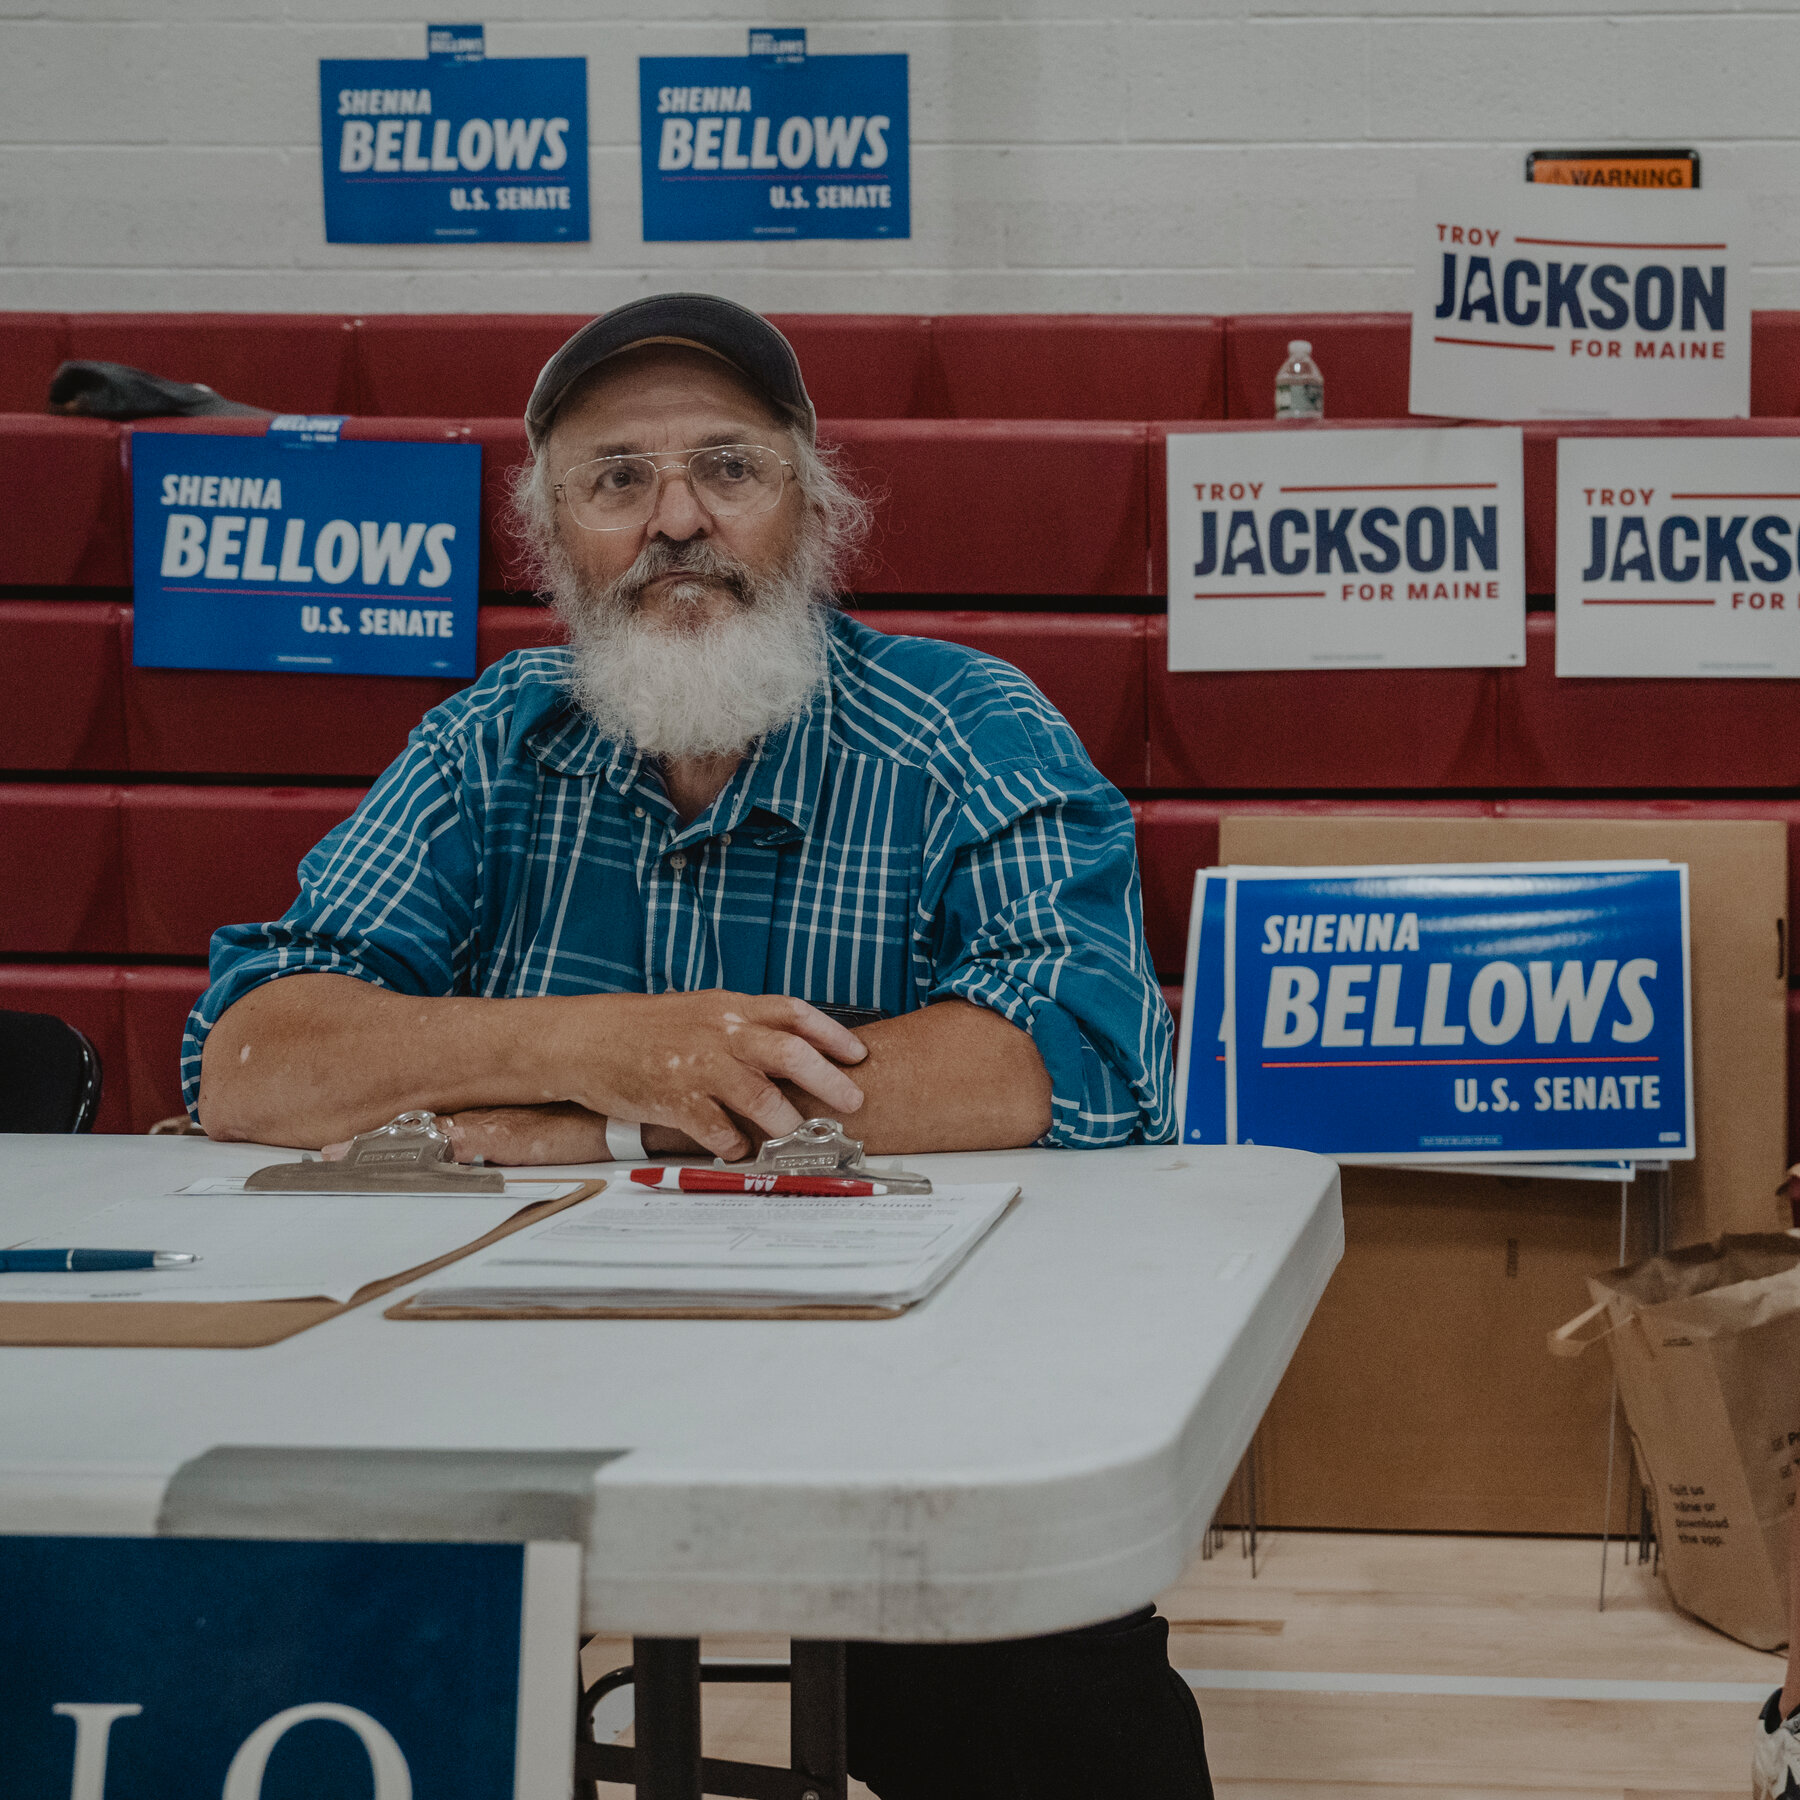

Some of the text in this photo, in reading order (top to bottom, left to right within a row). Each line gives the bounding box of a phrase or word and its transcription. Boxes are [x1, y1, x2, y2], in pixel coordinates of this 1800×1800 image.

[337, 88, 432, 116] SHENNA
[656, 85, 752, 114] SHENNA
[338, 116, 570, 173] BELLOWS
[657, 114, 891, 171] BELLOWS
[1570, 168, 1684, 187] WARNING
[449, 185, 572, 212] U.S. SENATE
[769, 183, 892, 210] U.S. SENATE
[1436, 222, 1501, 248] TROY
[1435, 251, 1727, 333] JACKSON
[1570, 338, 1725, 360] FOR MAINE
[160, 473, 282, 510] SHENNA
[1193, 481, 1264, 501] TROY
[1583, 487, 1655, 507] TROY
[160, 513, 457, 588] BELLOWS
[1194, 504, 1499, 578] JACKSON
[1583, 514, 1800, 584] JACKS
[1341, 580, 1499, 602] FOR MAINE
[1731, 591, 1786, 611] FOR
[300, 604, 455, 639] U.S. SENATE
[1261, 911, 1421, 955] SHENNA
[1261, 957, 1659, 1050] BELLOWS
[1453, 1074, 1662, 1114] U.S. SENATE
